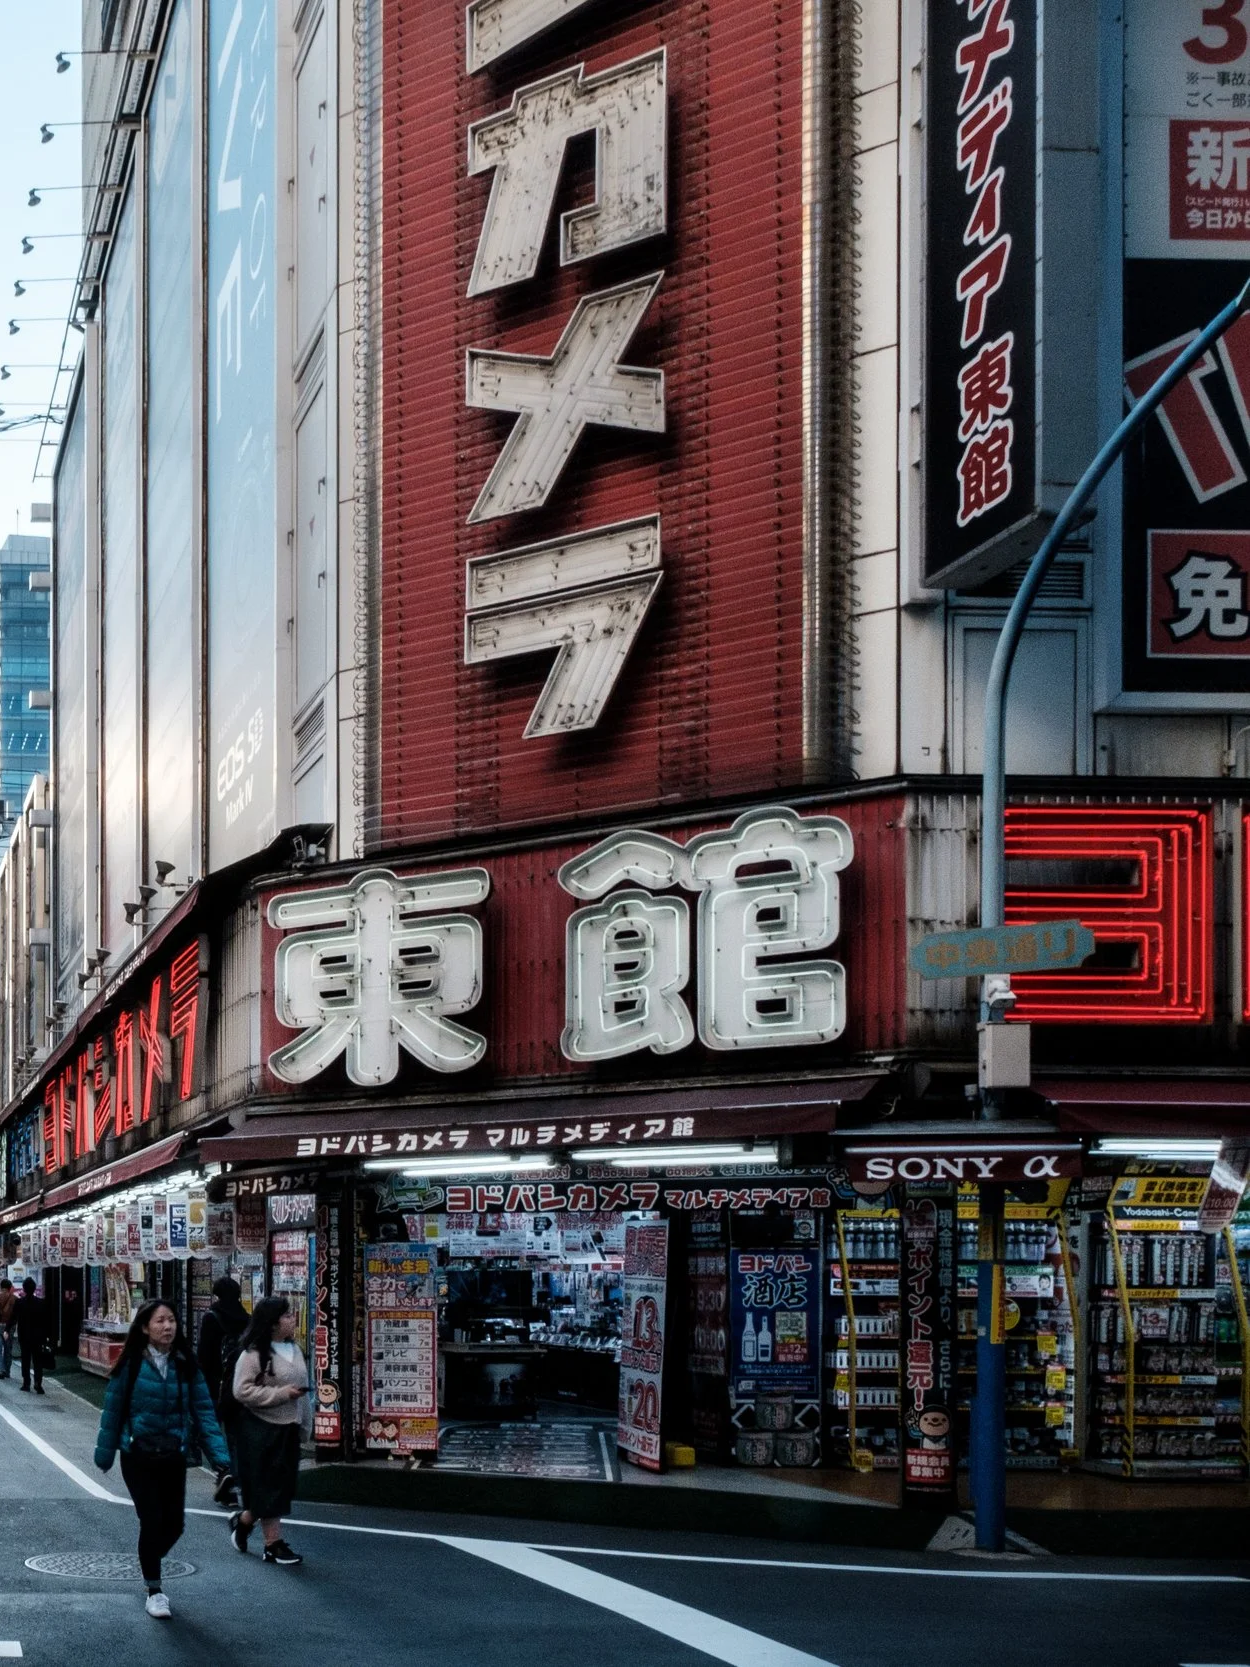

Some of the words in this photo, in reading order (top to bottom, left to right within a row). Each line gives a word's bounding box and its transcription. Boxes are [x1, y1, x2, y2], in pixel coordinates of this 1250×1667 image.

[217, 731, 245, 801] EOS
[225, 785, 244, 830] Mark
[267, 806, 855, 1087] 東館
[925, 927, 1077, 969] 中央通り
[296, 1131, 470, 1156] ヨドバシカメラ
[486, 1117, 695, 1147] マルチメディア館
[865, 1156, 1004, 1180] SONY
[1022, 1155, 1061, 1179] α
[447, 1182, 661, 1213] ヨドバシカメラ
[664, 1188, 831, 1210] マルチメディア館
[1123, 1206, 1200, 1218] Yodobashi-Came
[738, 1254, 813, 1274] ヨドバシ
[741, 1273, 808, 1309] 酒店
